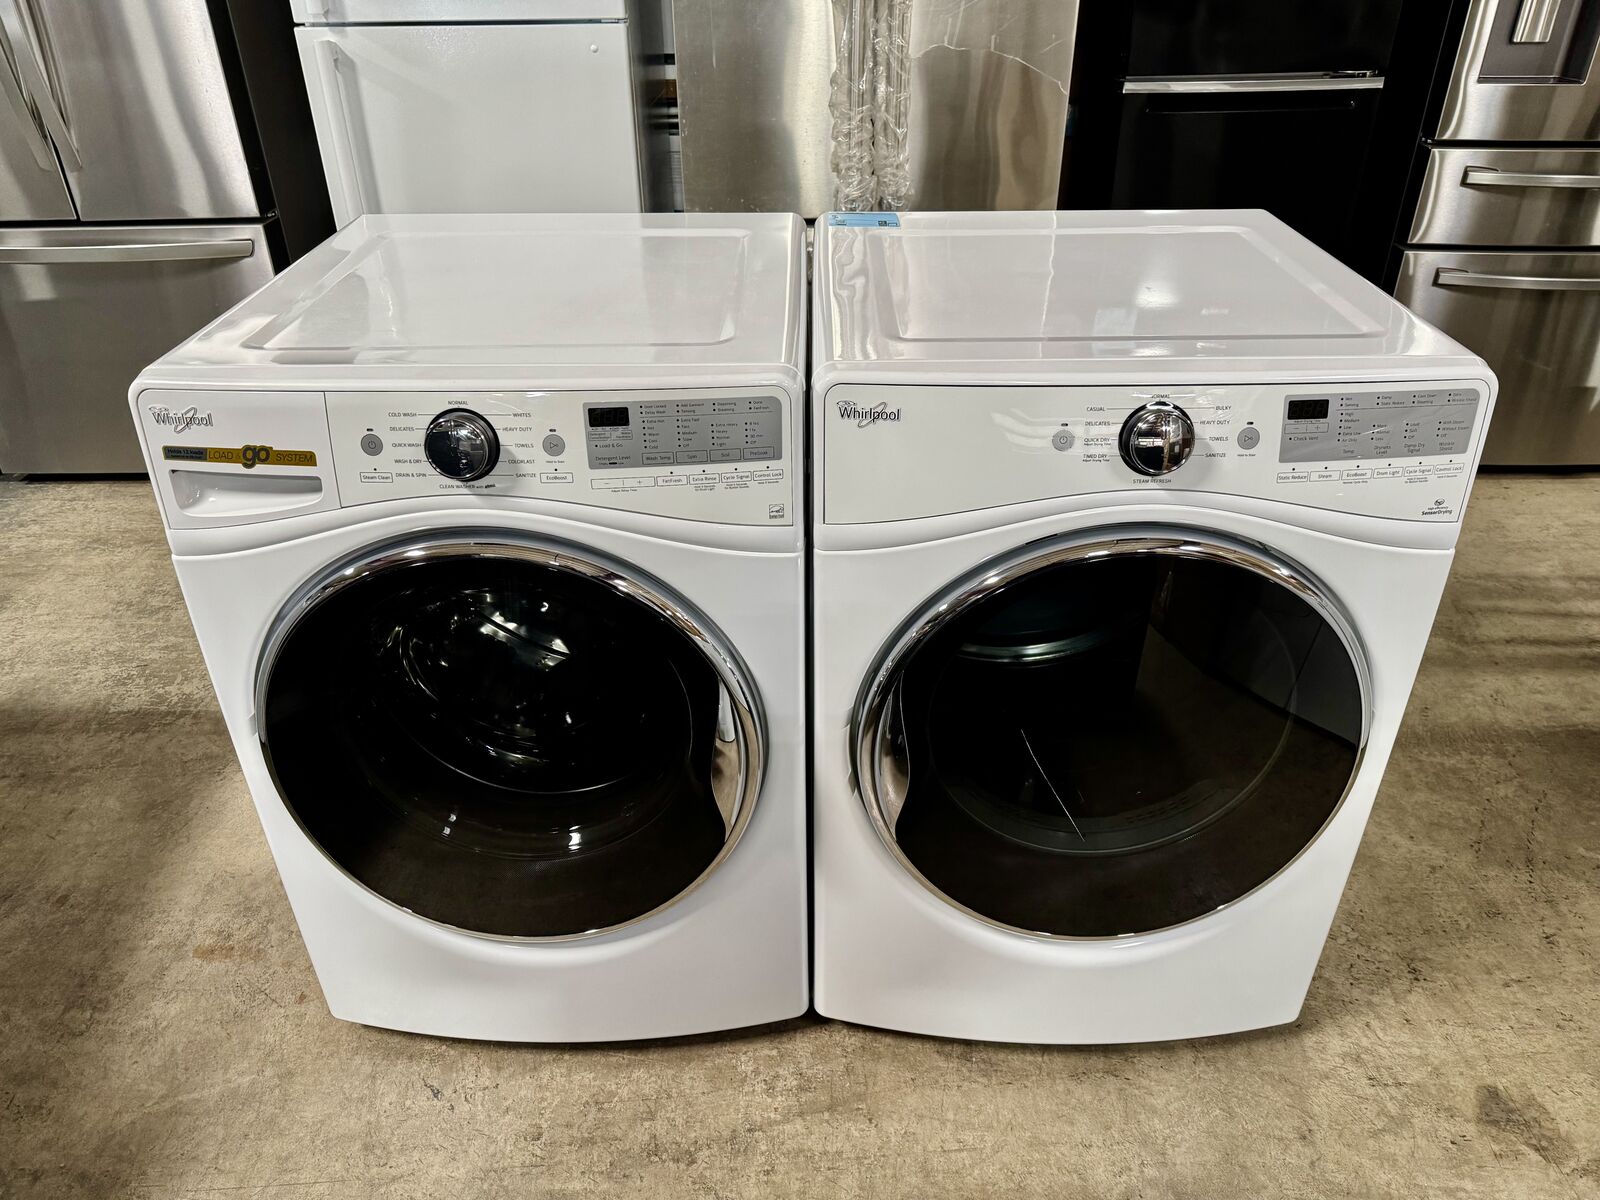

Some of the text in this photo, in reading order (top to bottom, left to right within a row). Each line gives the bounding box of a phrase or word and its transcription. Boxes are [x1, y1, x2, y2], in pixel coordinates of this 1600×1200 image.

[150, 408, 214, 430] Whirlpool
[838, 404, 900, 425] Whirlpool
[208, 450, 233, 460] LOAD
[276, 454, 312, 462] SYSTEM
